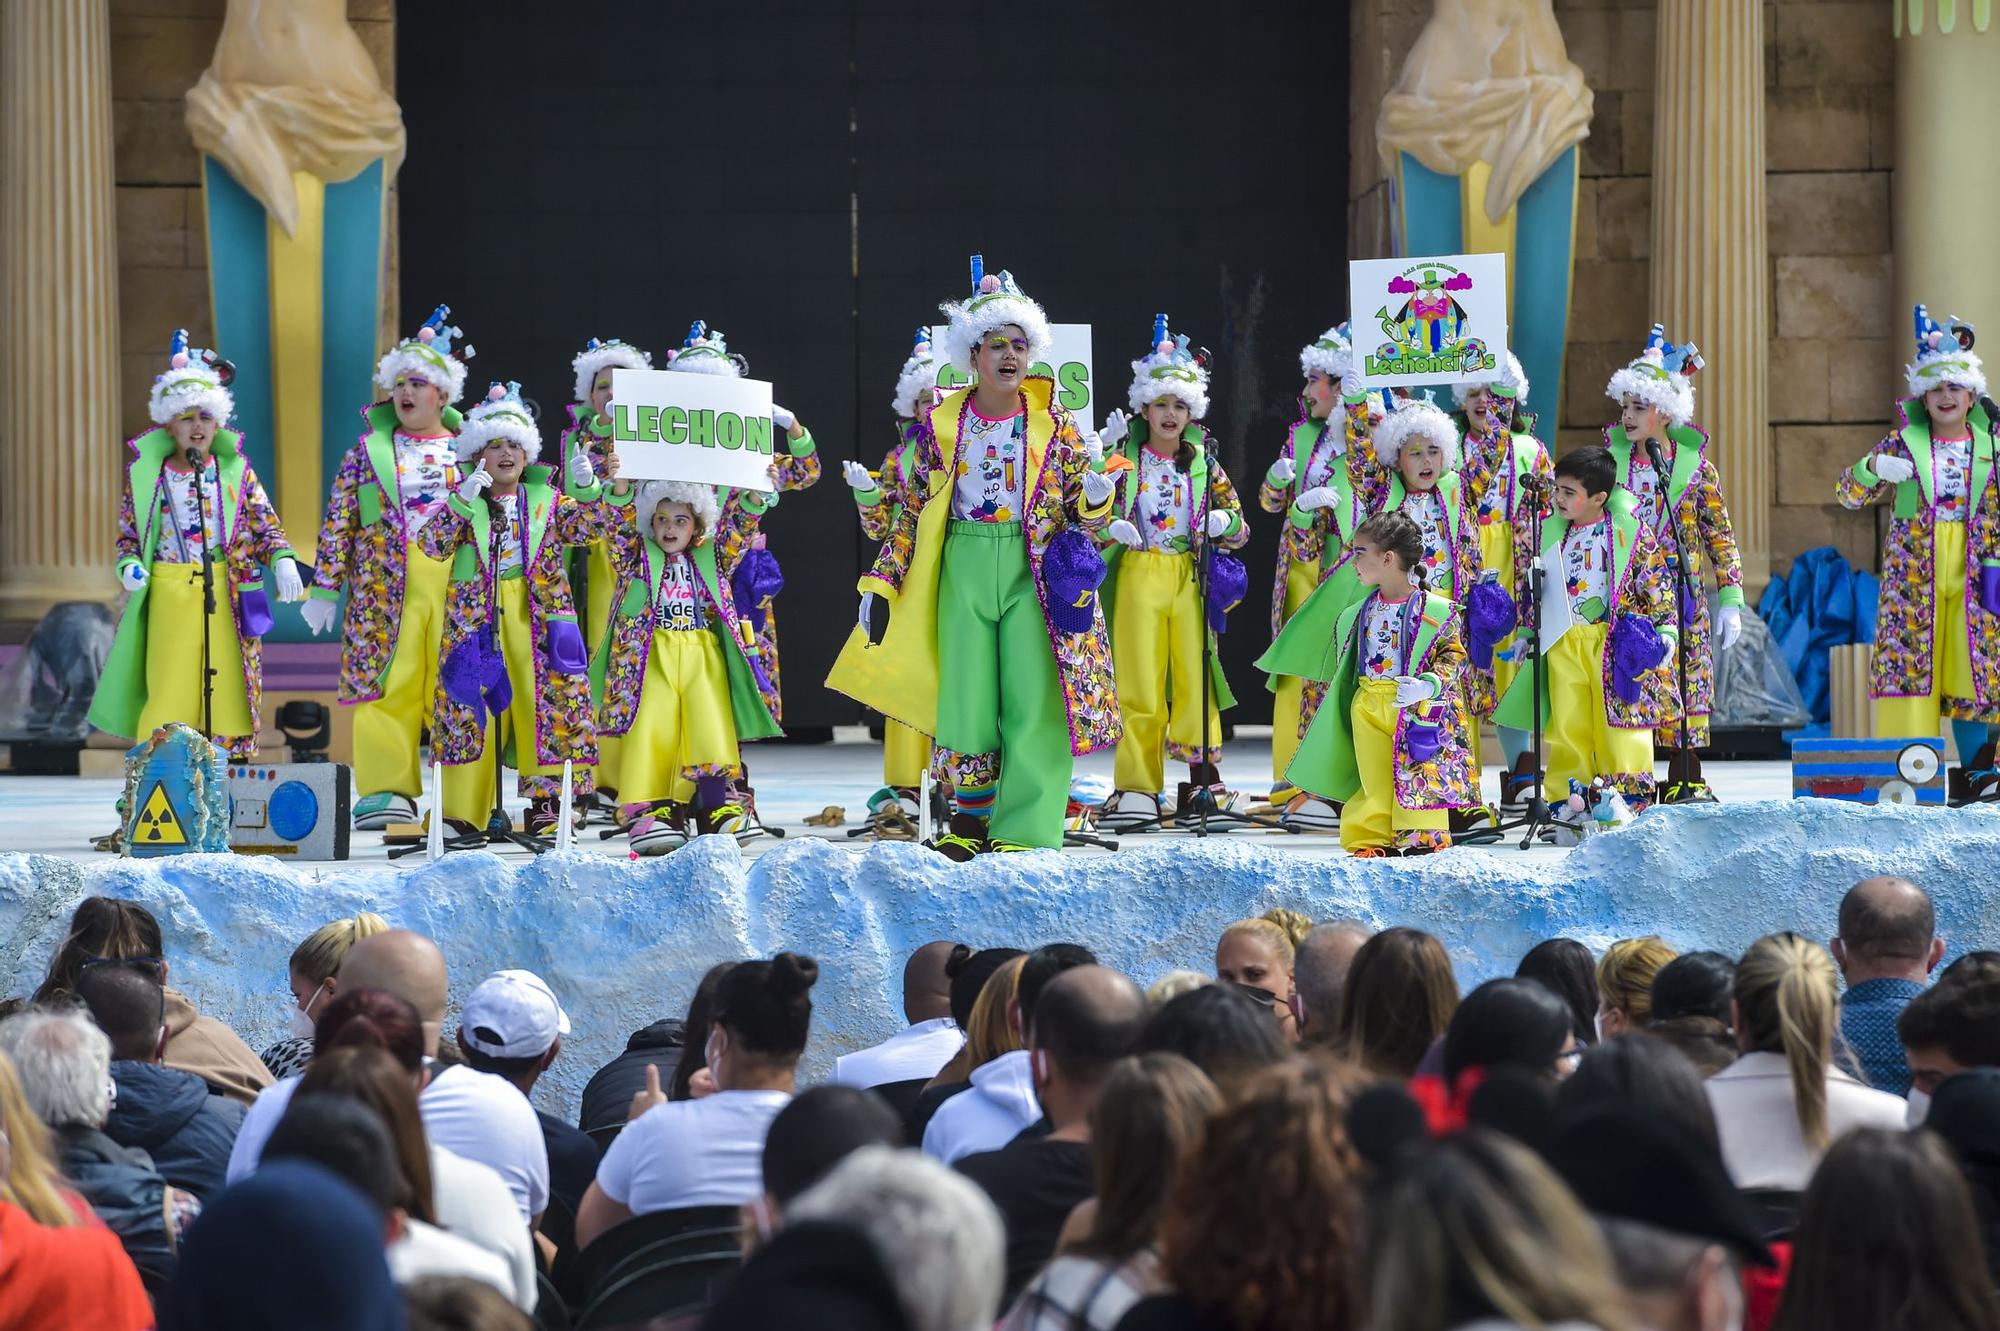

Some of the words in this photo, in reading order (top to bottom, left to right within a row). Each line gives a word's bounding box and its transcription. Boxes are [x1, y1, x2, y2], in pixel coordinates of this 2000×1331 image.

[1365, 350, 1496, 377] Lechoncis
[614, 404, 773, 455] LECHON
[984, 482, 1000, 495] H2O
[1072, 589, 1093, 608] L
